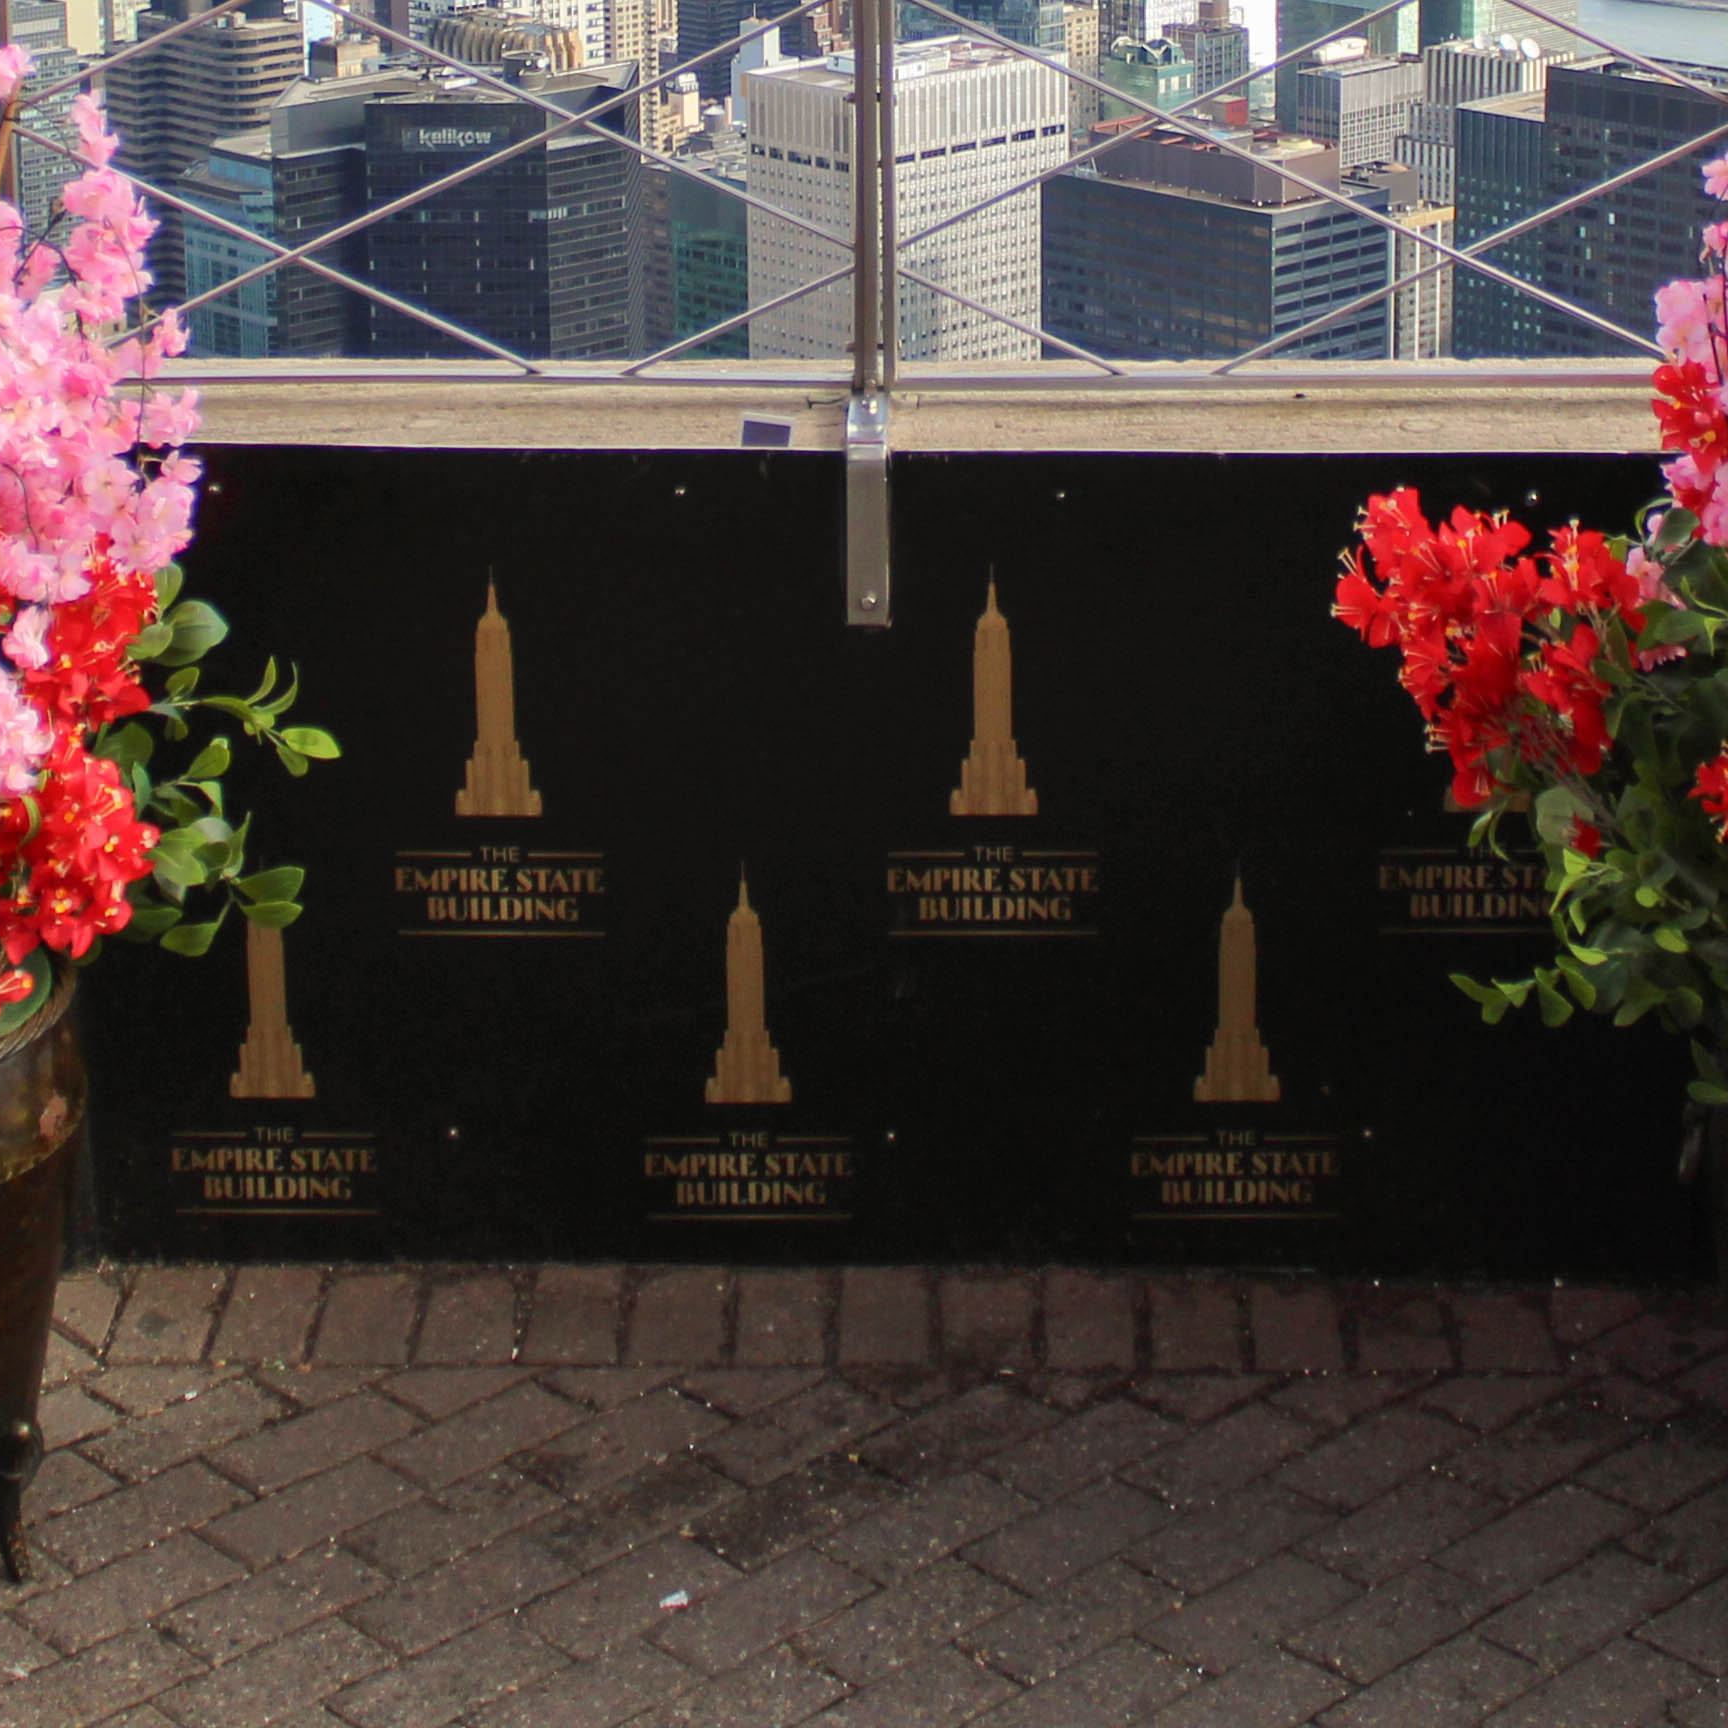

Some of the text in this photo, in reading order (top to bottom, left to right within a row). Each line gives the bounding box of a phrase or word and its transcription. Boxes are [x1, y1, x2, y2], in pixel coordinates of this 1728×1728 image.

[419, 128, 491, 150] kalikow
[479, 846, 521, 862] THE
[974, 846, 1014, 862] THE
[394, 868, 605, 894] EMPIRE STATE
[887, 869, 1098, 893] EMPIRE STATE
[427, 896, 579, 921] BUILDING
[919, 897, 1072, 921] BUILDING
[254, 1127, 294, 1143] THE
[729, 1132, 770, 1148] THE
[1216, 1130, 1257, 1146] THE
[173, 1149, 377, 1173] EMPIRE STATE
[644, 1153, 852, 1177] EMPIRE STATE
[1130, 1152, 1340, 1176] EMPIRE STATE
[204, 1175, 352, 1201] BUILDING
[676, 1181, 826, 1205] BUILDING
[1162, 1180, 1312, 1204] BUILDING
